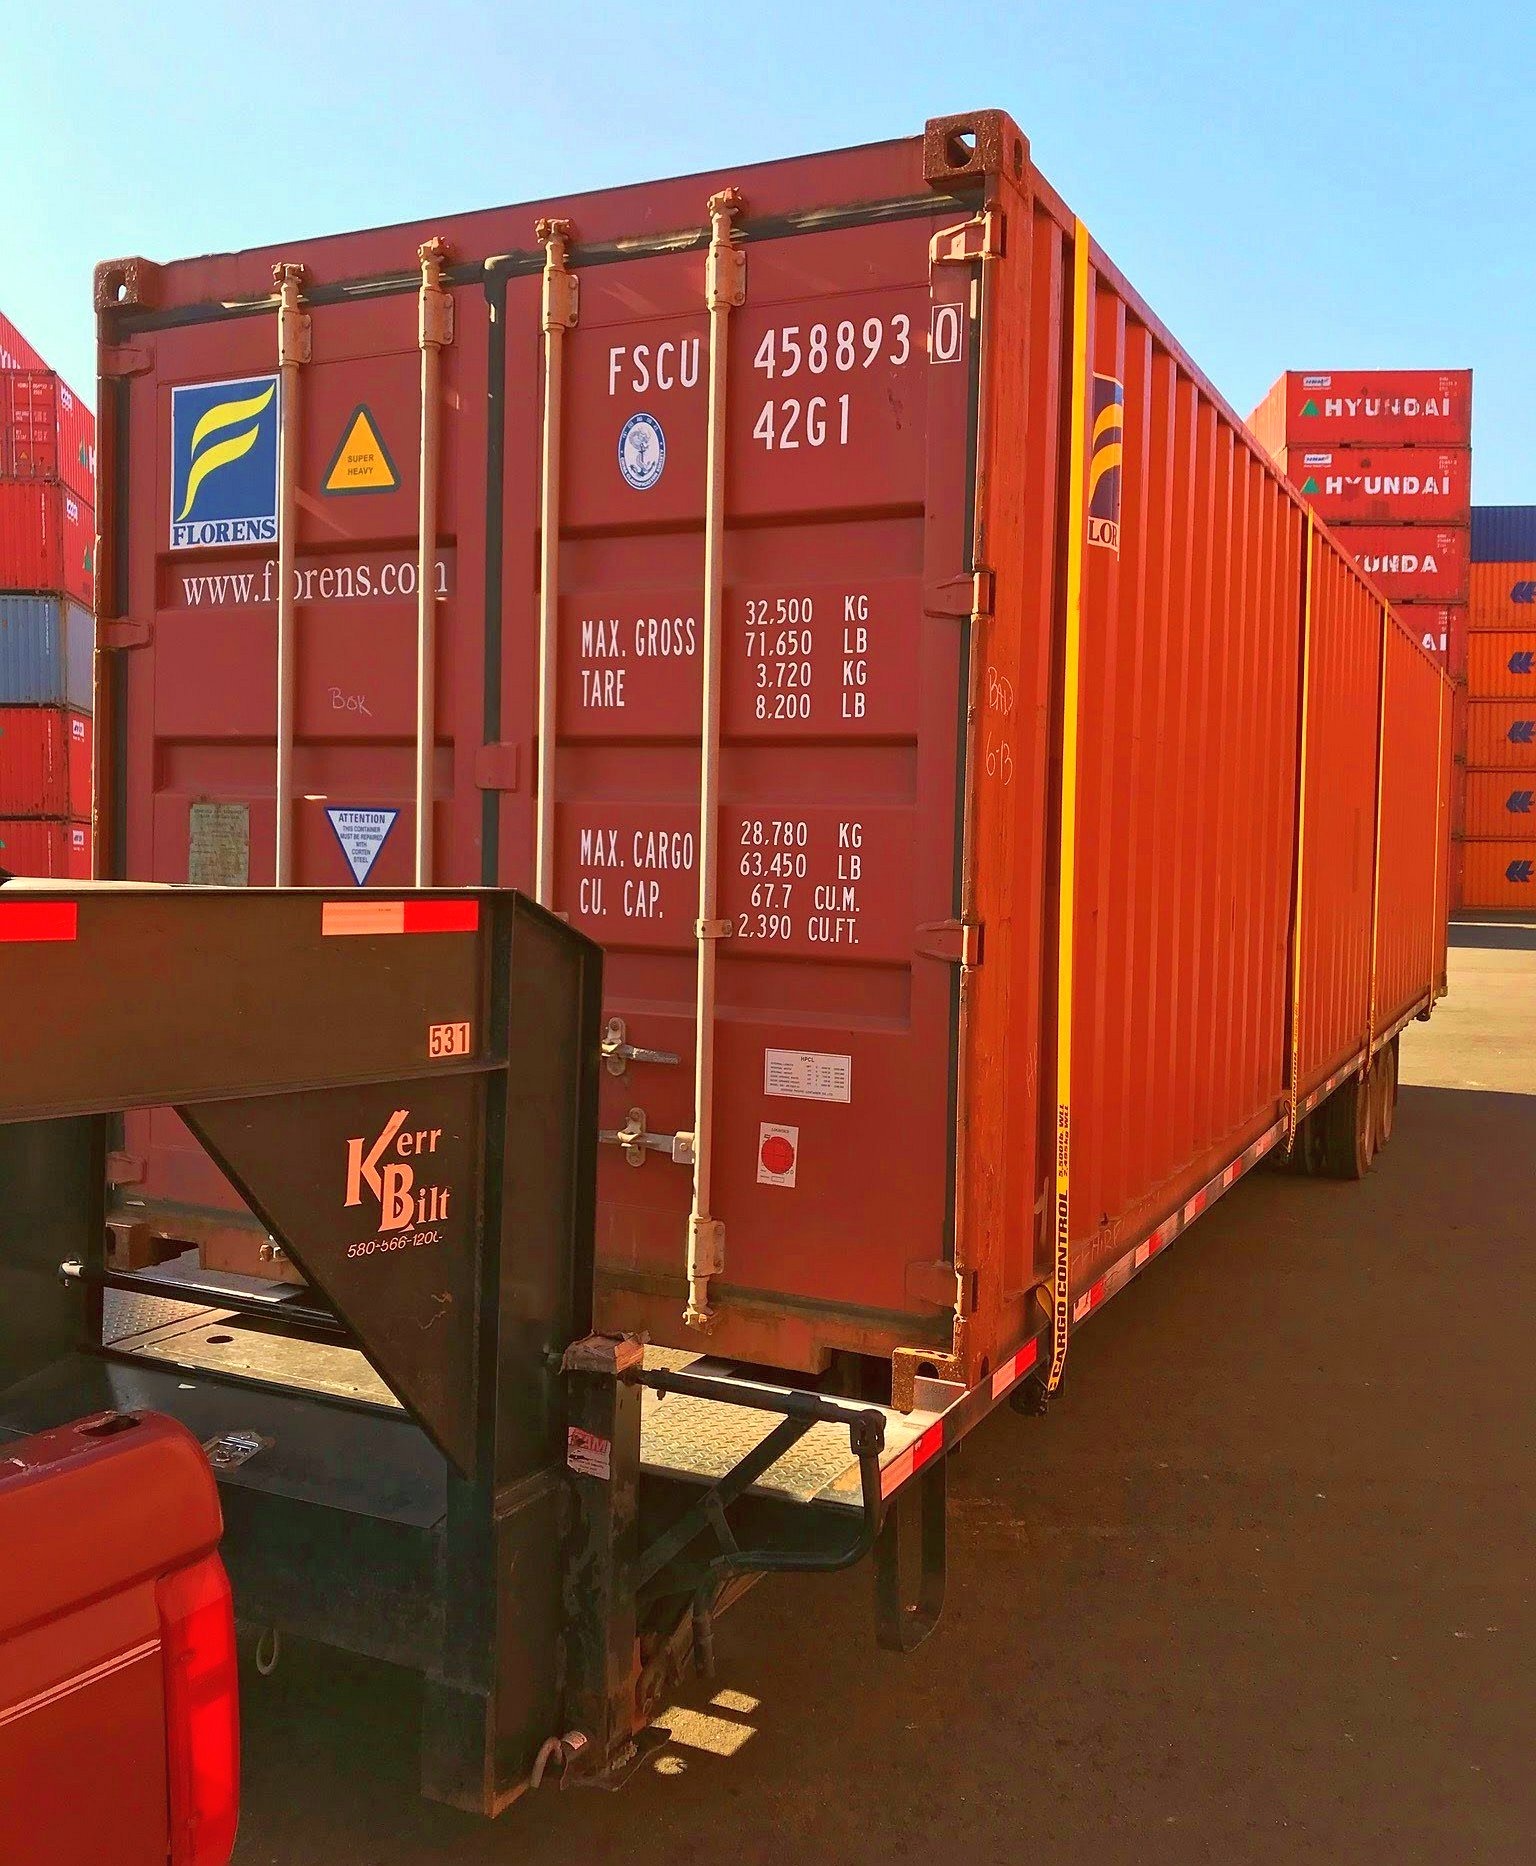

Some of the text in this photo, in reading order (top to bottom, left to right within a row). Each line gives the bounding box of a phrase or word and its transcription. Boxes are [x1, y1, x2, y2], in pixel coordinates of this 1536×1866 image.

[609, 307, 958, 396] FSCU 458893 0
[752, 393, 850, 450] 42G1
[1325, 398, 1450, 417] HYUNDAI
[347, 453, 375, 463] SUPER
[347, 466, 374, 476] HEAVY
[172, 518, 277, 547] FLORENS
[182, 560, 448, 606] www.forens.com
[745, 594, 869, 626] 32,500 KG
[581, 617, 696, 658] MAX. GROSS
[745, 627, 868, 657] 71,650 LB
[581, 669, 626, 707] TARE
[756, 660, 867, 688] 3,720 KG
[755, 691, 866, 720] 8,200 LB
[338, 813, 386, 824] ATTENTION
[580, 829, 694, 870] MAX. CARGO
[740, 820, 863, 849] 28,780 KG
[740, 852, 862, 881] 63,450 LB
[580, 877, 664, 919] CU. CAP.
[751, 883, 861, 912] 67.7 CU.M.
[738, 913, 860, 944] 2,390 CU.FT.
[431, 1025, 466, 1055] 531
[343, 1109, 442, 1208] Kerr
[377, 1163, 451, 1233] Bilt
[1057, 1190, 1068, 1298] CONTROL
[1053, 1300, 1067, 1377] CARGO
